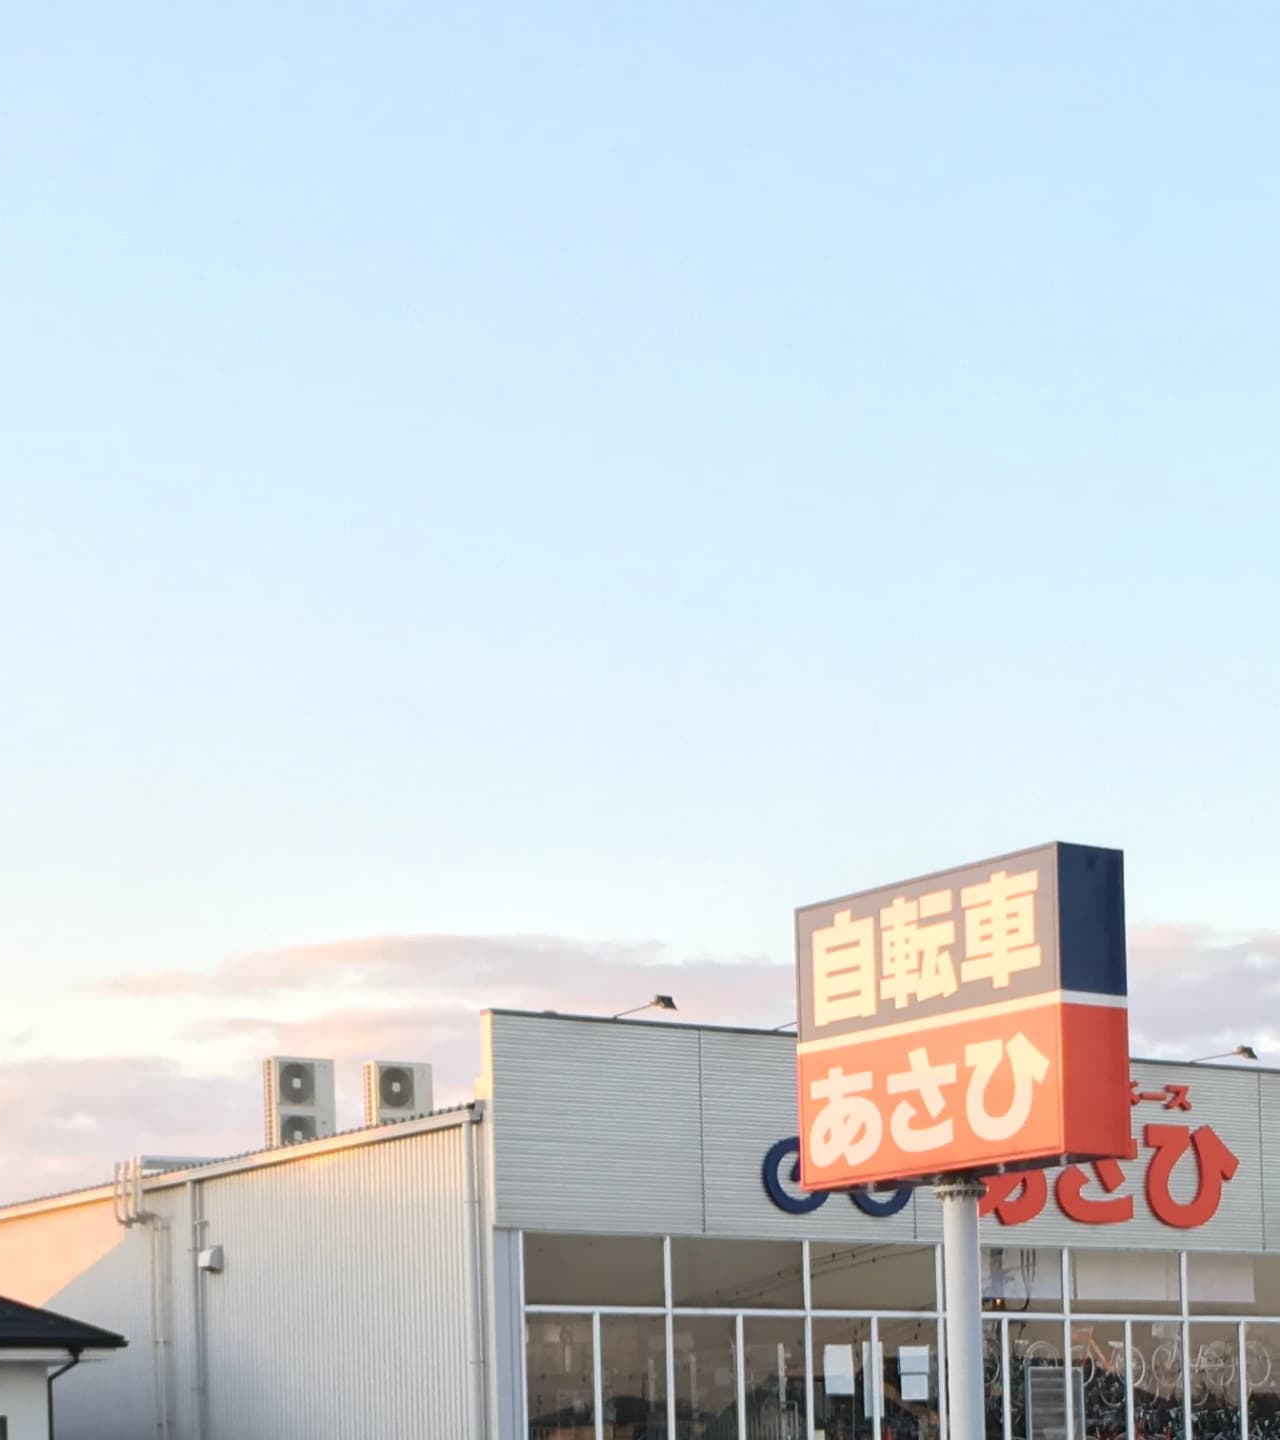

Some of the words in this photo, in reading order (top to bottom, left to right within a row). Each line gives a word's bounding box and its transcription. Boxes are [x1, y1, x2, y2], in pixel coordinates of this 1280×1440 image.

[812, 870, 1042, 1027] 自転車
[809, 1031, 1051, 1168] あさひ
[1129, 1081, 1193, 1111] ース
